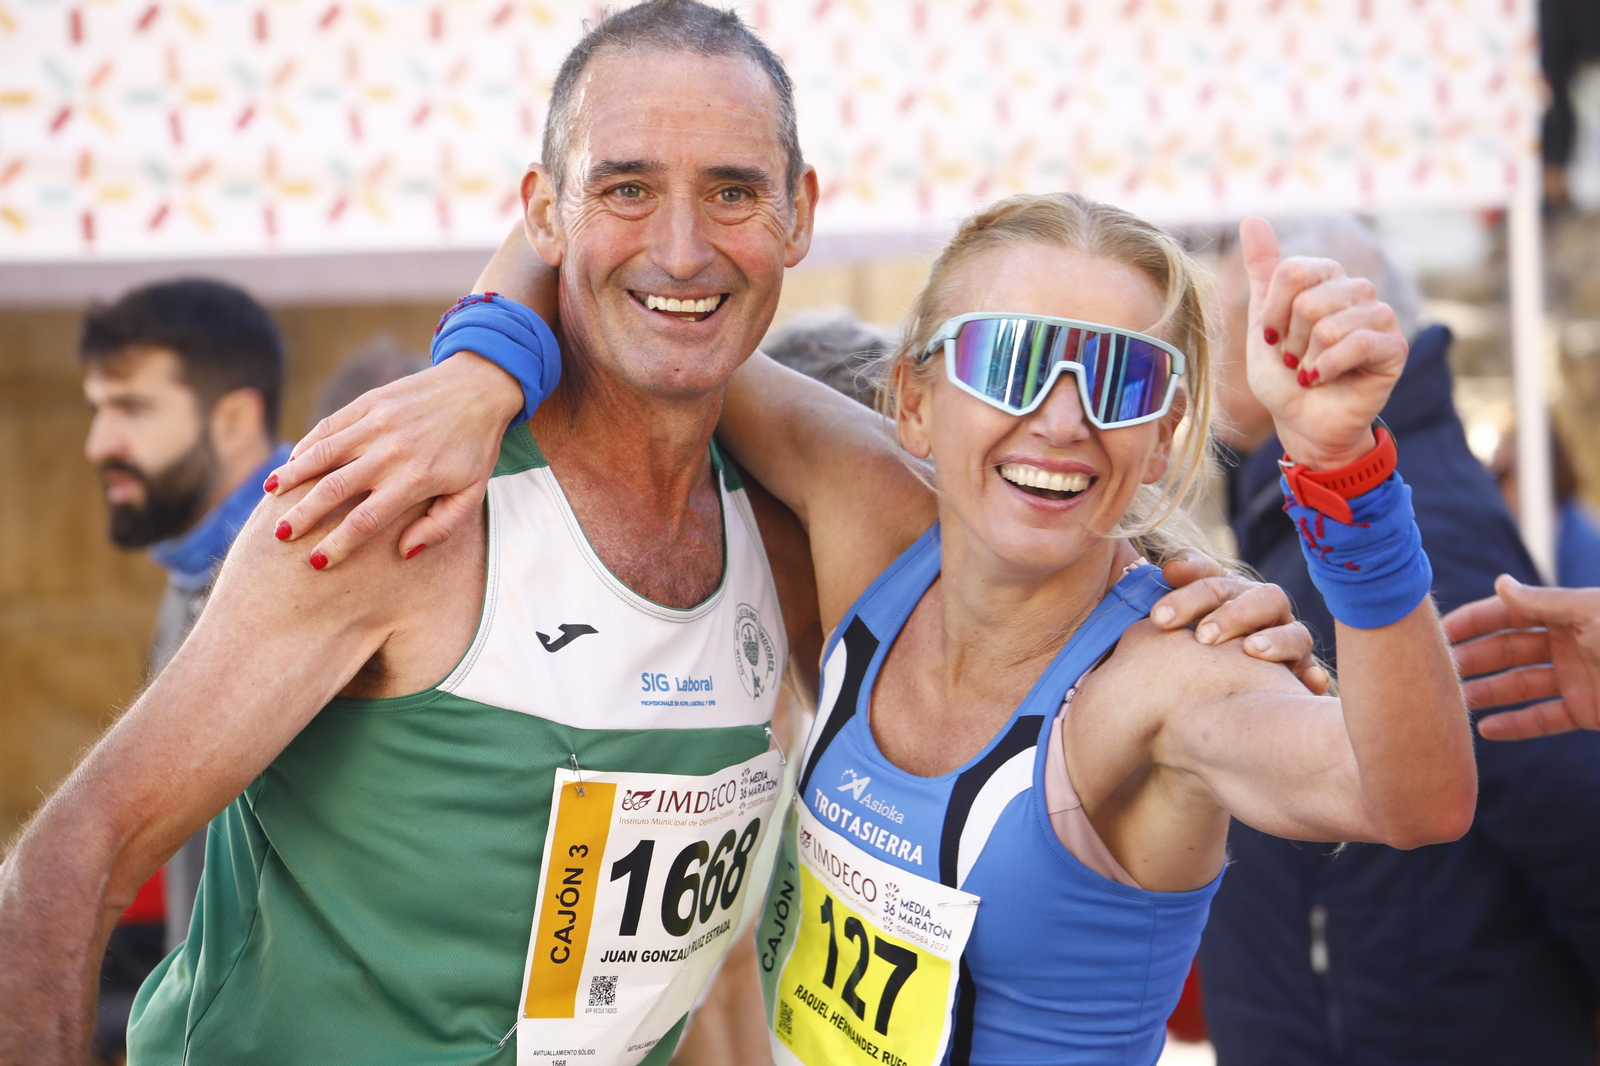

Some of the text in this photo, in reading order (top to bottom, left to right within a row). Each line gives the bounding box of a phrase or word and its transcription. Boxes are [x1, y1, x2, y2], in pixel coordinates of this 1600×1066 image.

[641, 672, 713, 692] SIG Laboral
[740, 777, 778, 800] 36 MARATÓN
[749, 770, 768, 785] MEDIA
[656, 780, 736, 814] IMDECO
[859, 793, 905, 825] Asioka
[619, 817, 648, 826] Instituto
[650, 818, 687, 828] Municipal
[699, 816, 719, 826] Deportes
[814, 788, 923, 866] TROTASIERRA
[610, 817, 761, 937] 1668
[813, 838, 877, 902] IMDECO
[550, 844, 589, 965] CAJÓN 3
[883, 897, 932, 919] 36 MEDIA
[600, 949, 638, 963] JUAN
[690, 934, 706, 954] RUIZ
[705, 918, 731, 945] ESTRADA
[762, 879, 795, 973] CAJÓN
[898, 911, 953, 939] MARATÓN
[929, 940, 950, 953] 2022
[820, 894, 918, 1037] 127
[794, 984, 830, 1019] RAQUEL
[829, 1011, 879, 1060] HERNANDEZ
